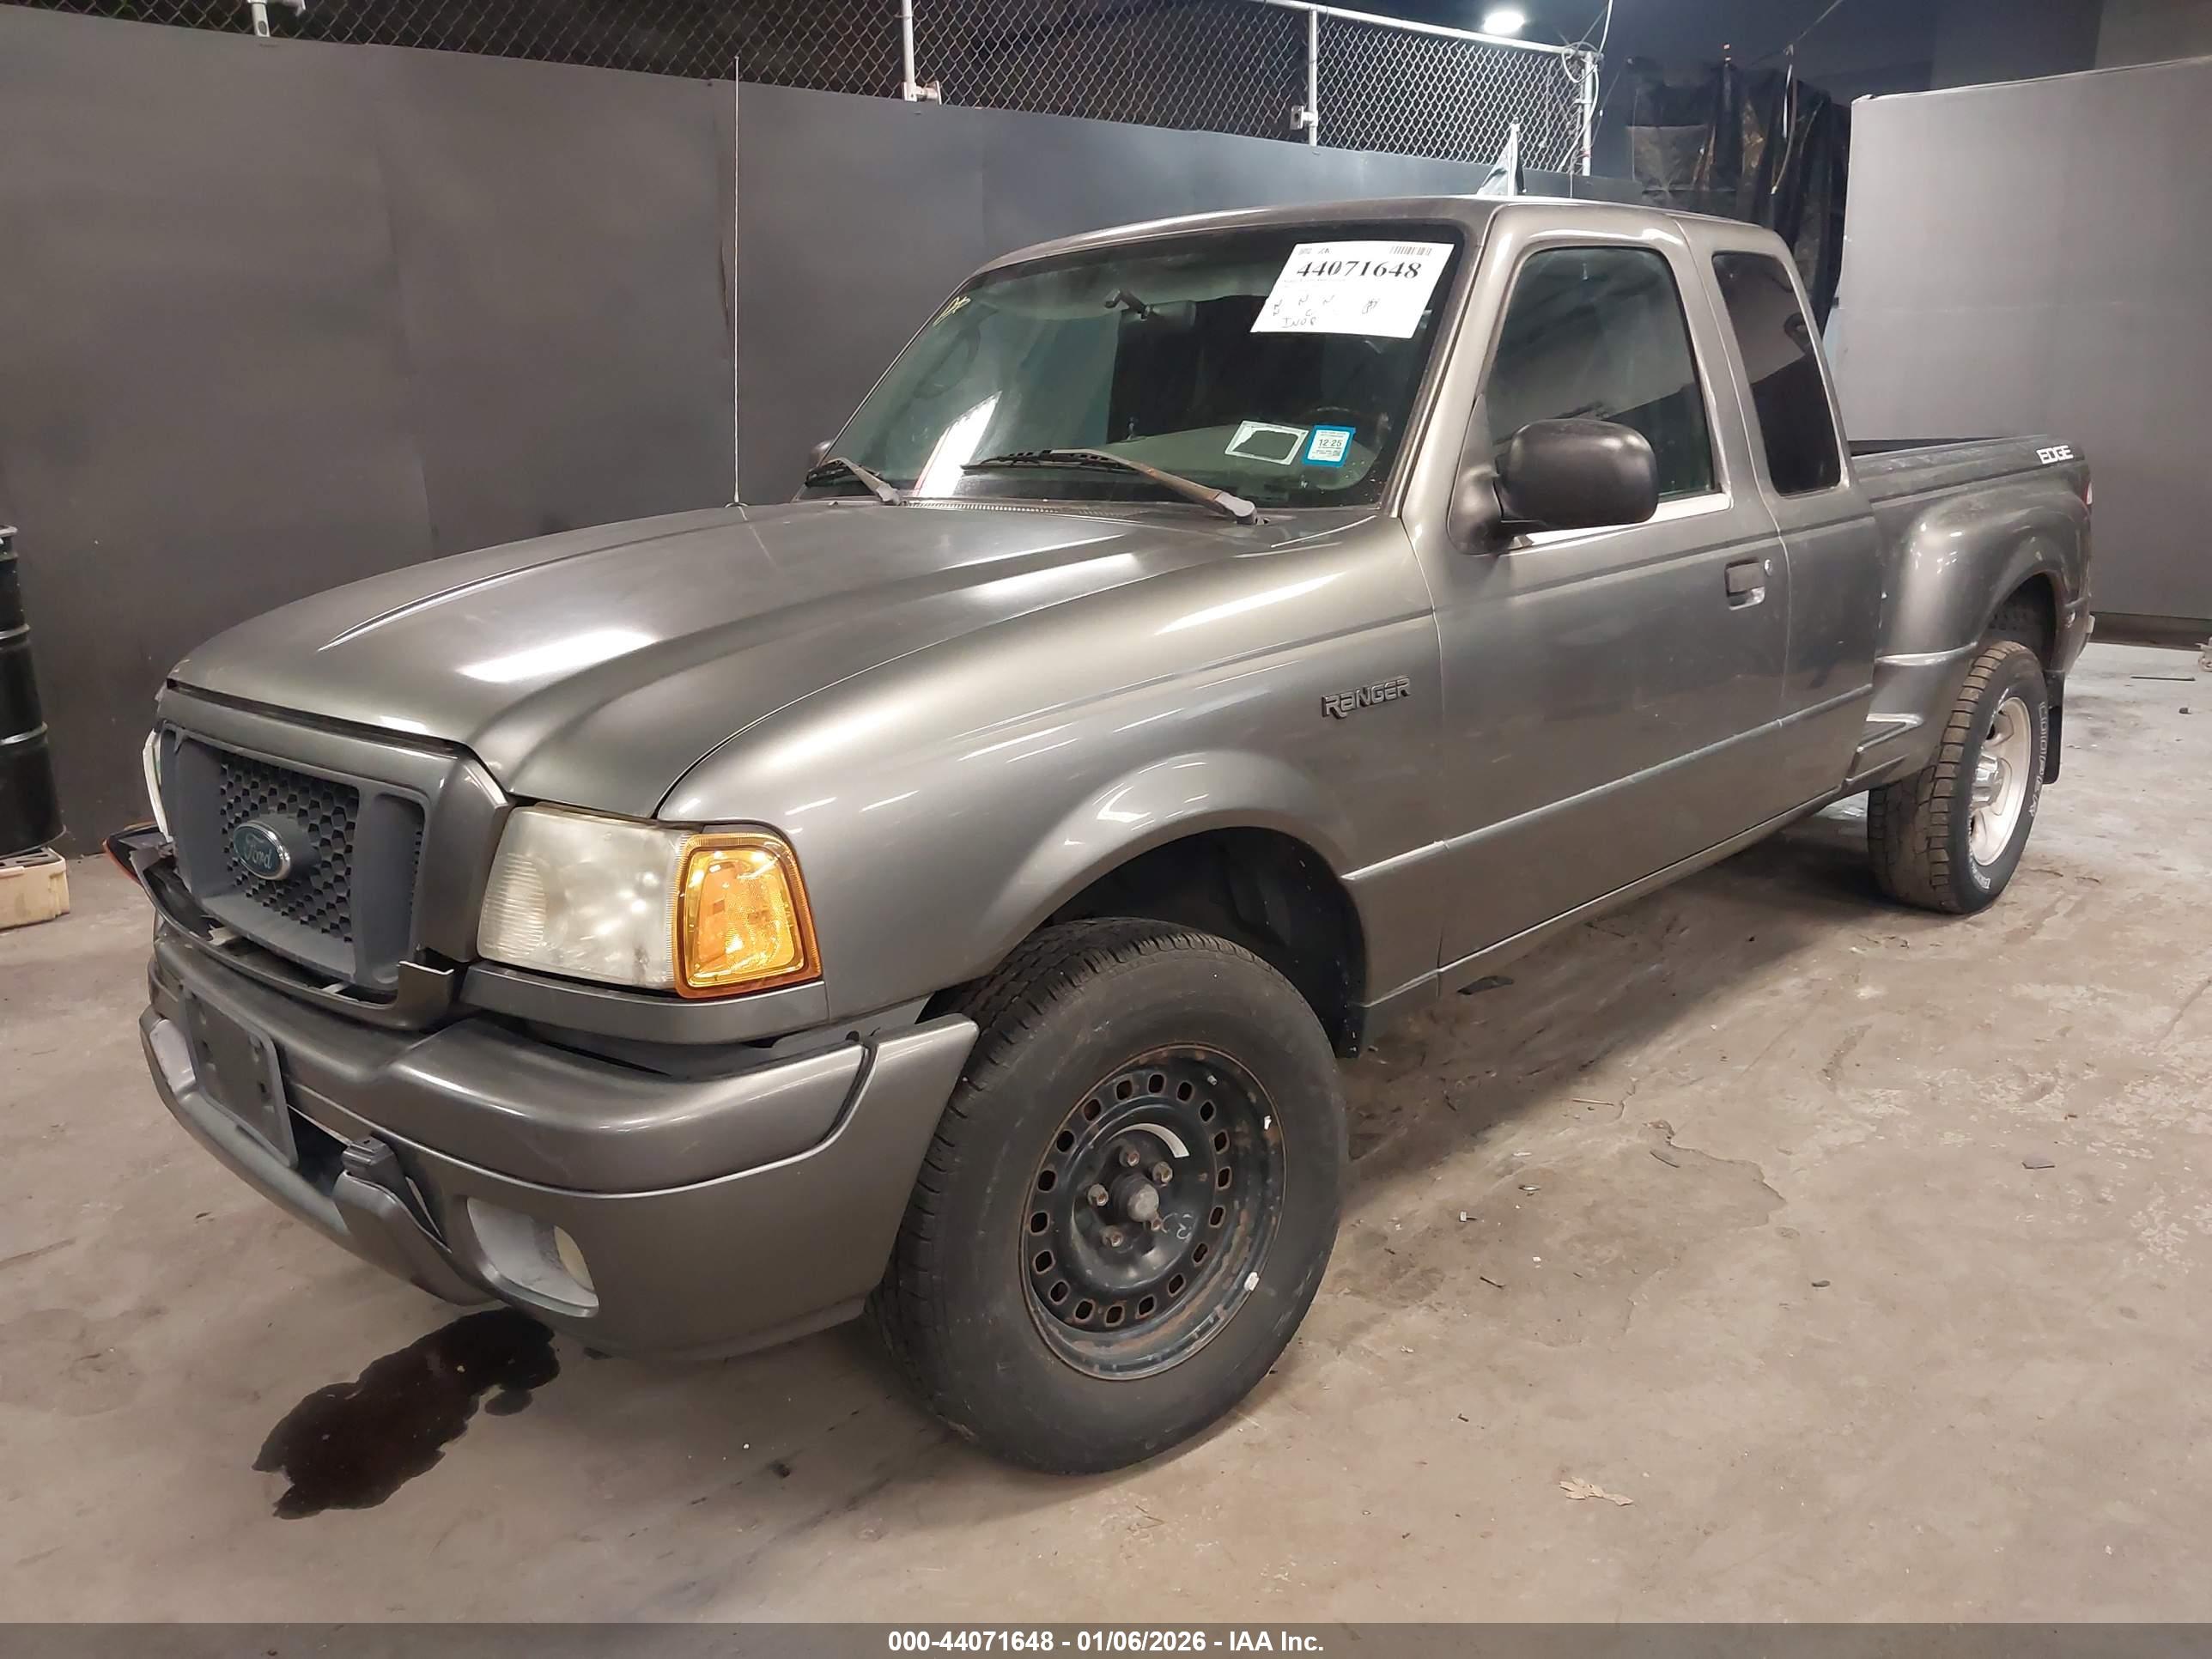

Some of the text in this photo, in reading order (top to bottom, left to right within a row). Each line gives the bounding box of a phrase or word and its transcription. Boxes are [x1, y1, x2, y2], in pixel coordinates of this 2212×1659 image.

[1297, 260, 1422, 278] 44071648
[2036, 445, 2074, 465] EDGE
[1322, 675, 1410, 719] RANGER
[244, 833, 273, 870] Ford
